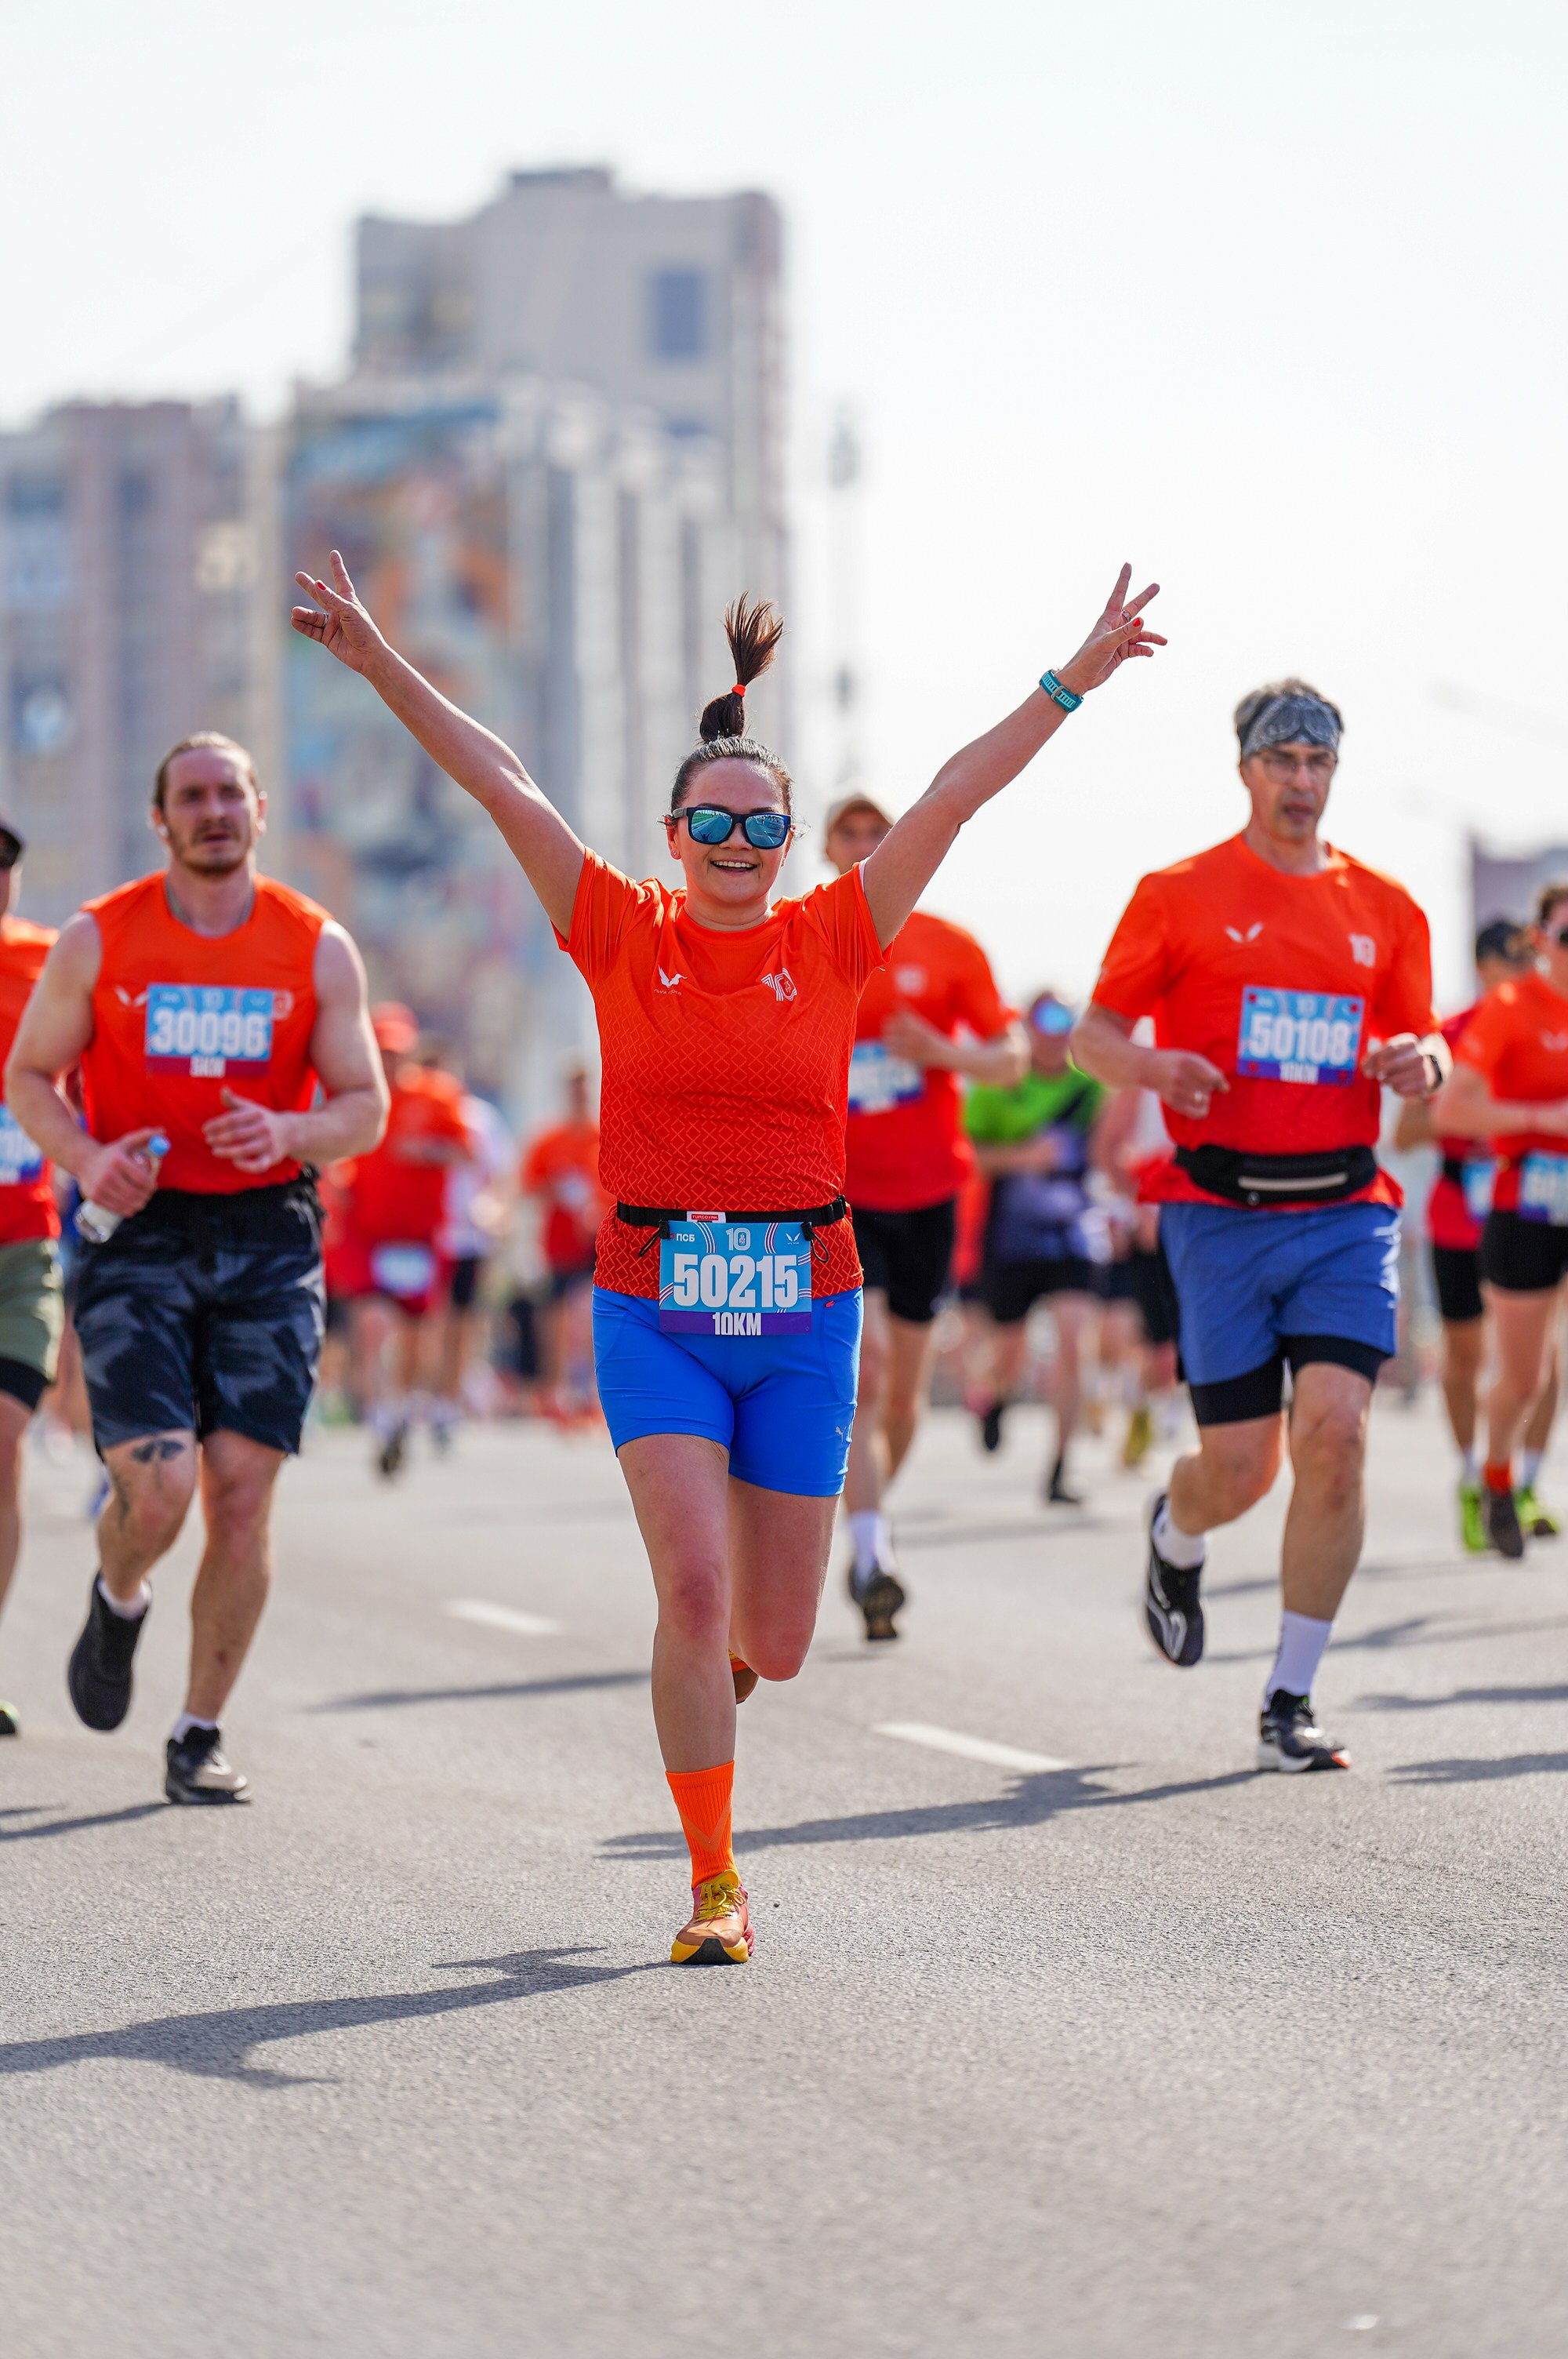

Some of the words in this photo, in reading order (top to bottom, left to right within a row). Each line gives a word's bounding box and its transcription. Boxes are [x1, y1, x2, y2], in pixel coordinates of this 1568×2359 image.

[153, 1008, 268, 1058] 30096
[1249, 1012, 1352, 1066] 50108
[676, 1234, 695, 1242] ПСБ
[725, 1227, 751, 1251] 10
[673, 1253, 798, 1308] 50215
[712, 1312, 761, 1336] 10KM
